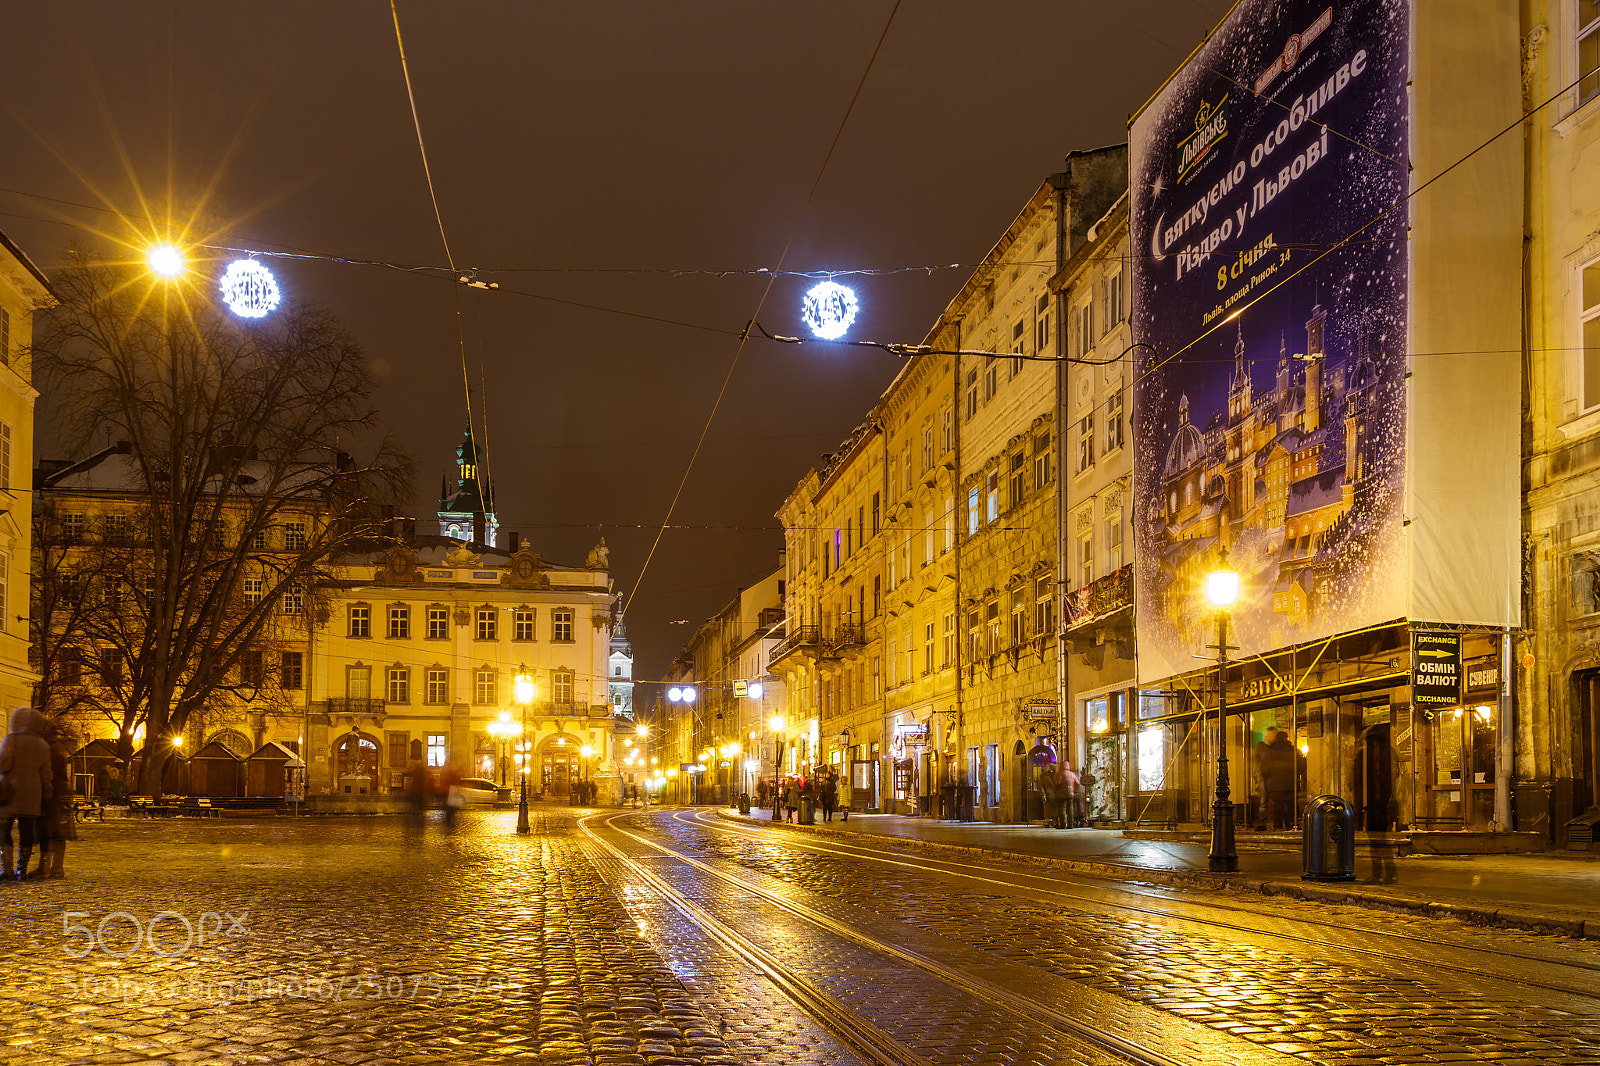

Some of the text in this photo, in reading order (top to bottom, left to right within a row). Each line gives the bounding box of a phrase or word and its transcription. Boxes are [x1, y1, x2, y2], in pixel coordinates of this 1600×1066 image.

[1298, 50, 1320, 75] ЗАХОДУ
[1251, 49, 1367, 168] особливе
[1176, 124, 1329, 282] Різдво у Львові
[1217, 232, 1274, 291] 8 січня
[1202, 248, 1291, 327] Львів, площа Ринок, 34
[1418, 636, 1457, 645] EXCHANGE
[1416, 674, 1457, 686] ВАЛЮТ
[1419, 662, 1456, 674] ОБМІН
[1417, 695, 1457, 704] EXCHANGE
